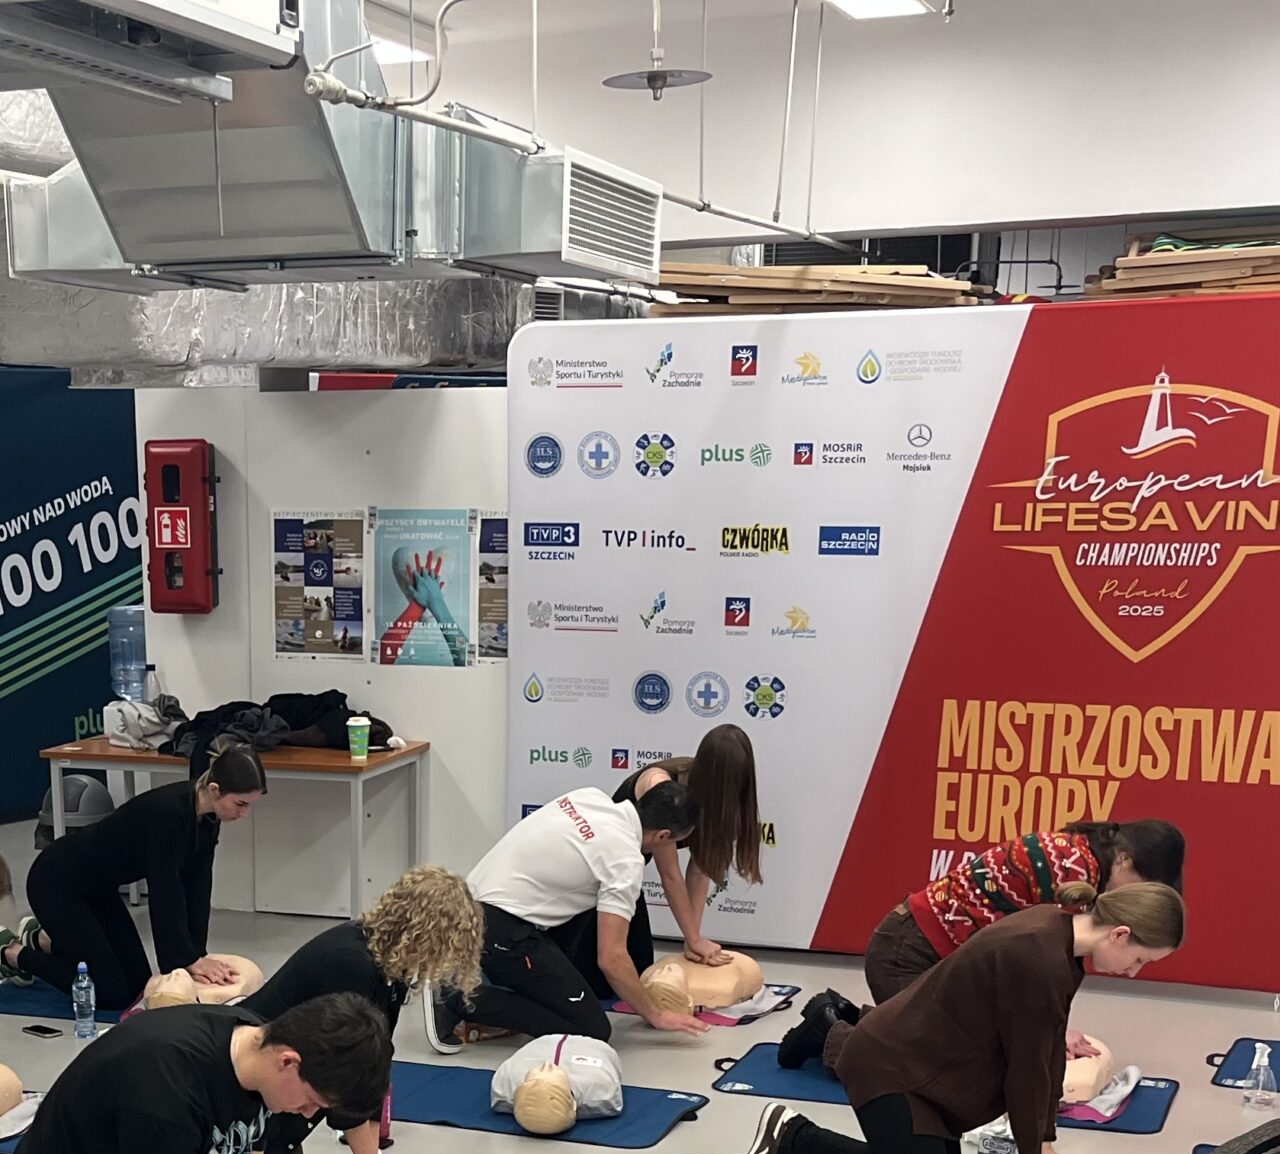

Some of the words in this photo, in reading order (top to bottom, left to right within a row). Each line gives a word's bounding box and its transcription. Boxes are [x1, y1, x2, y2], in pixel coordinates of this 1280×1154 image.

[555, 359, 608, 368] Ministerstwo
[555, 370, 583, 380] Sportu
[587, 370, 624, 380] Turystyki
[670, 371, 704, 380] Pomorze
[662, 379, 702, 388] Zachodnie
[822, 443, 863, 453] MOSRiR
[646, 451, 664, 459] CKS
[700, 443, 745, 466] plus
[822, 454, 866, 464] Szczecin
[886, 451, 952, 461] Mercedes-Benz
[902, 463, 932, 472] Mojsiuk
[1035, 455, 1280, 514] European
[32, 496, 66, 527] NAD
[65, 475, 114, 510] WODĄ
[67, 496, 142, 574] 100
[399, 532, 443, 540] URATOWAĆ
[602, 530, 638, 547] TVP
[721, 523, 789, 553] CZWÓRKA
[528, 551, 575, 560] SZCZECIN
[1075, 542, 1222, 567] CHAMPIONSHIPS
[1097, 577, 1190, 602] Poland
[553, 603, 604, 613] Ministerstwo
[1117, 604, 1165, 618] 2025
[553, 614, 579, 625] Sportu
[584, 614, 619, 625] Turystyki
[662, 618, 696, 627] Pomorze
[655, 626, 694, 634] Zachodnie
[755, 693, 775, 701] CKS
[74, 707, 105, 743] plu
[936, 699, 1280, 785] MISTRZOSTWA
[529, 745, 569, 765] plus
[932, 771, 1121, 844] EUROPY
[929, 848, 955, 882] W
[717, 904, 756, 915] Zachodnie
